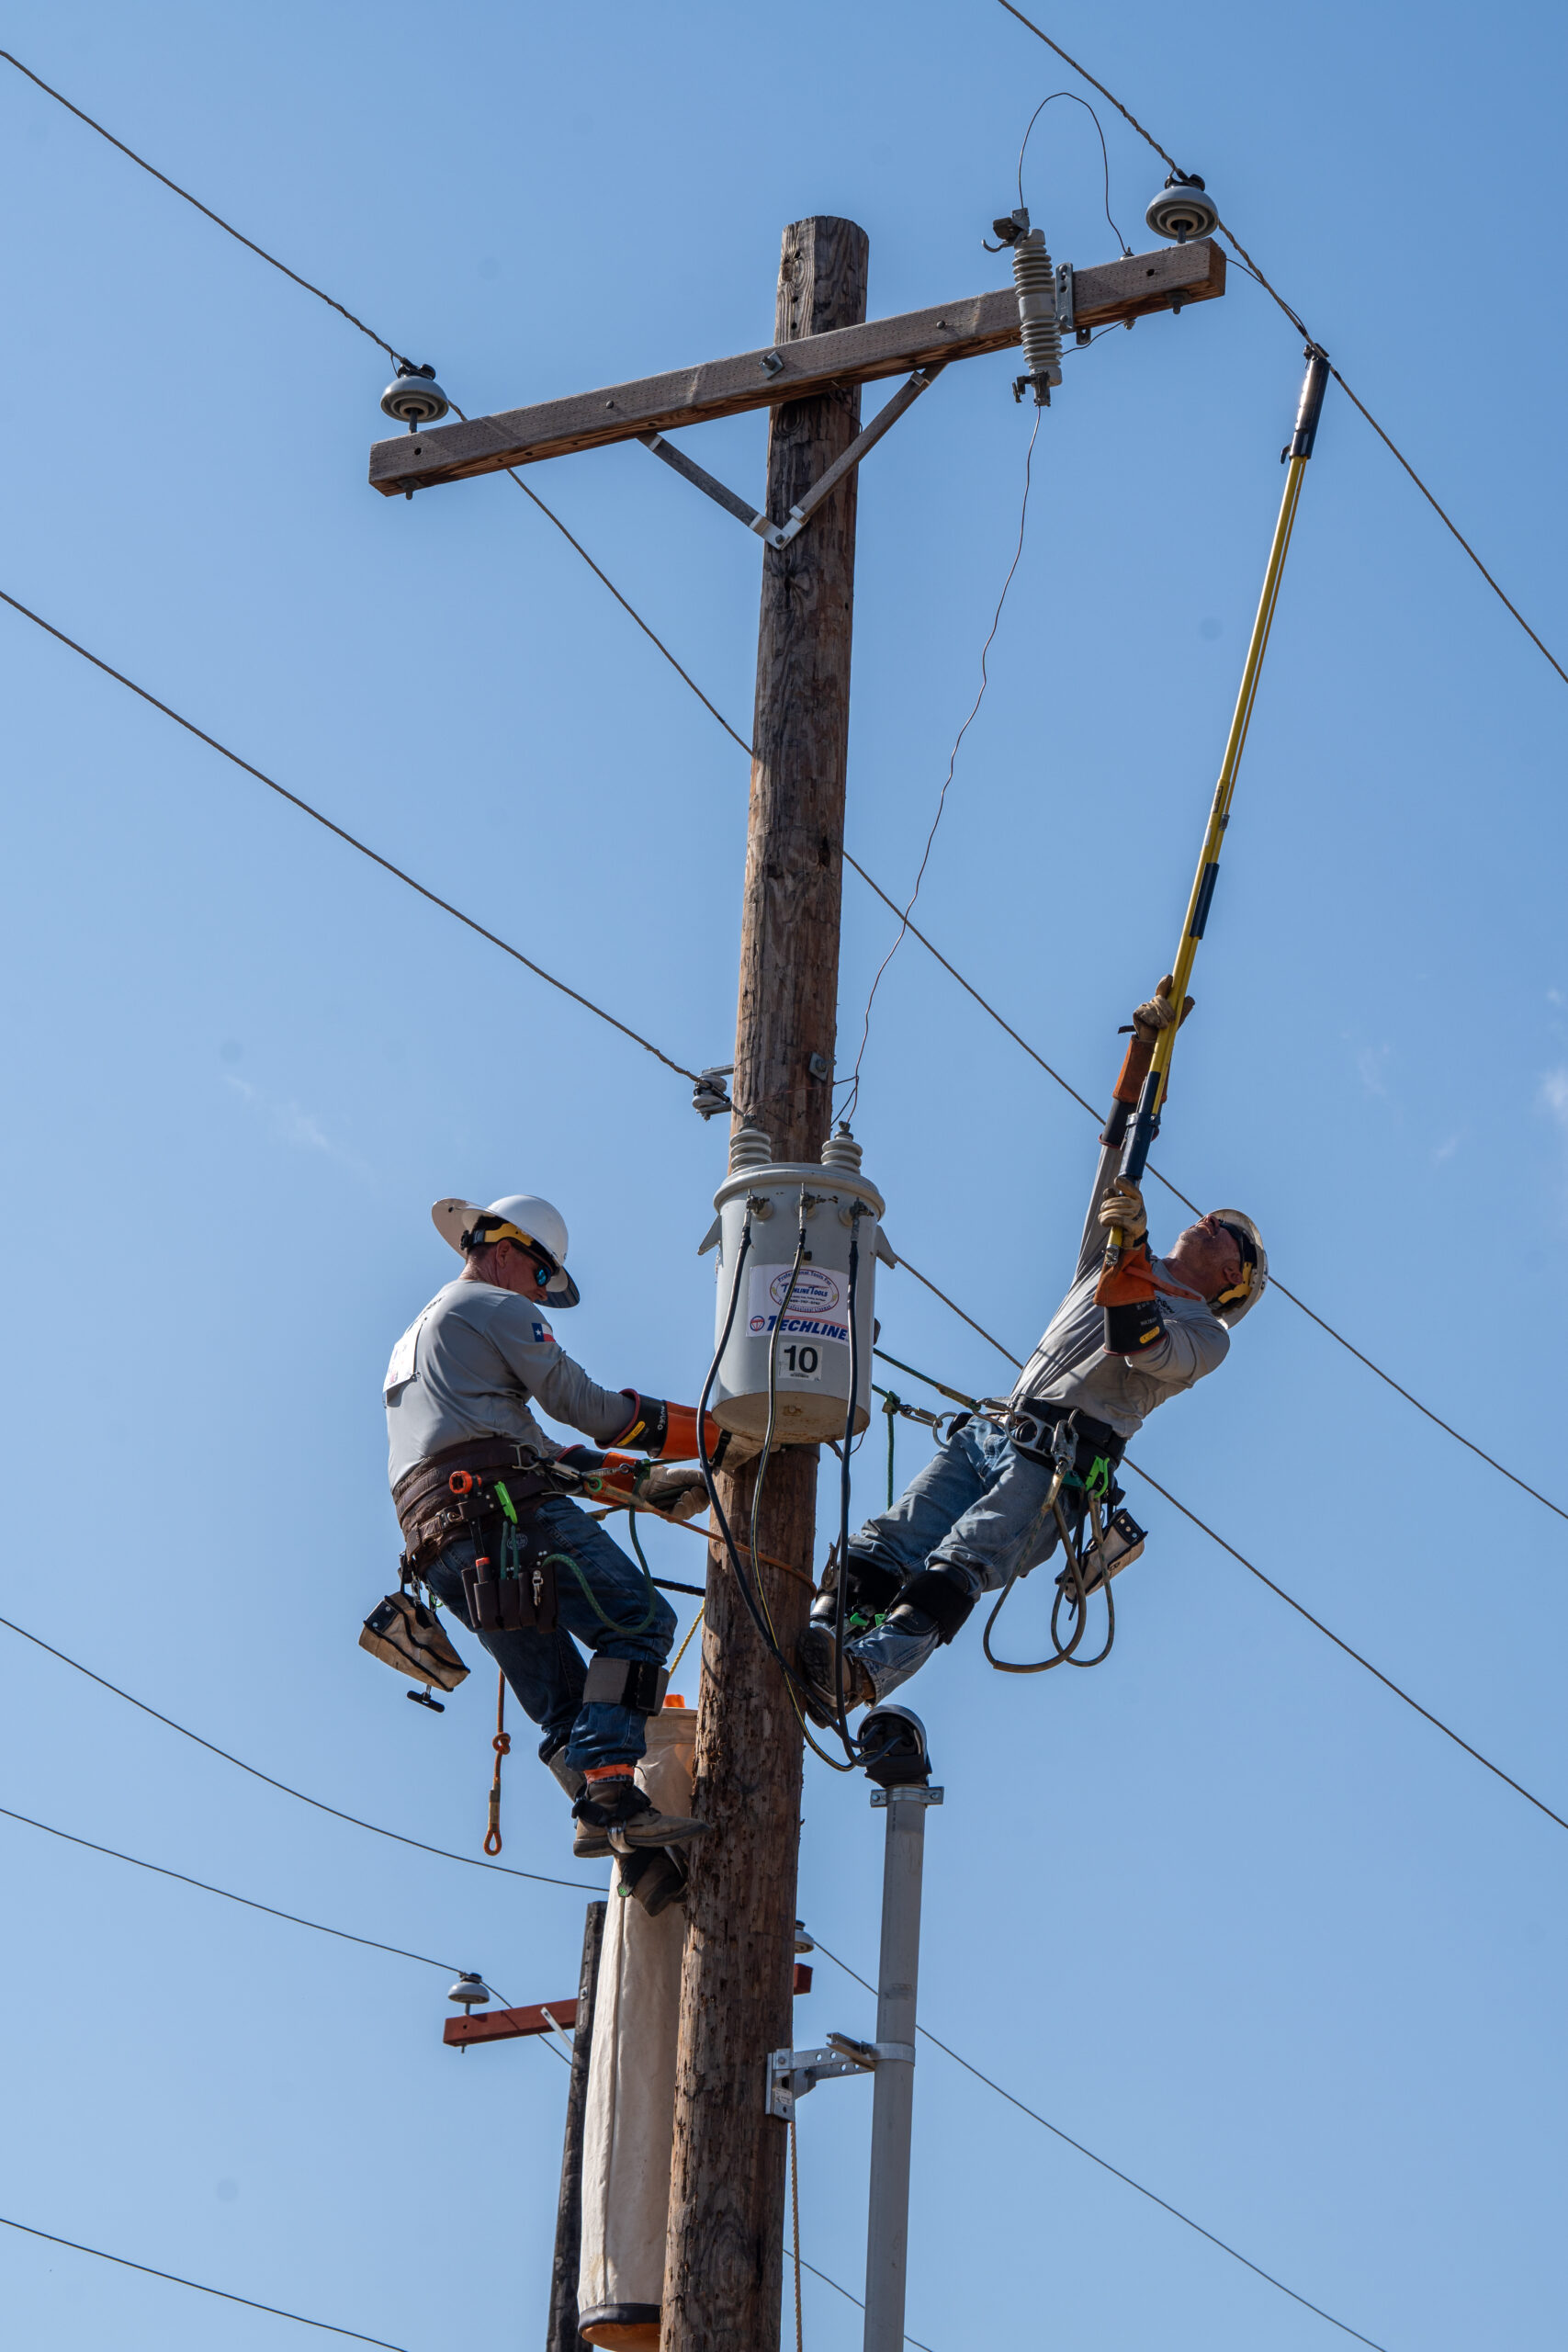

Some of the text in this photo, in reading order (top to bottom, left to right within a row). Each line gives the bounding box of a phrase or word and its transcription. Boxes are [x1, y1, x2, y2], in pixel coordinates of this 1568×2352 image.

[778, 1271, 808, 1282] Profeonal
[766, 1315, 848, 1340] TECHLINE
[784, 1345, 818, 1374] 10
